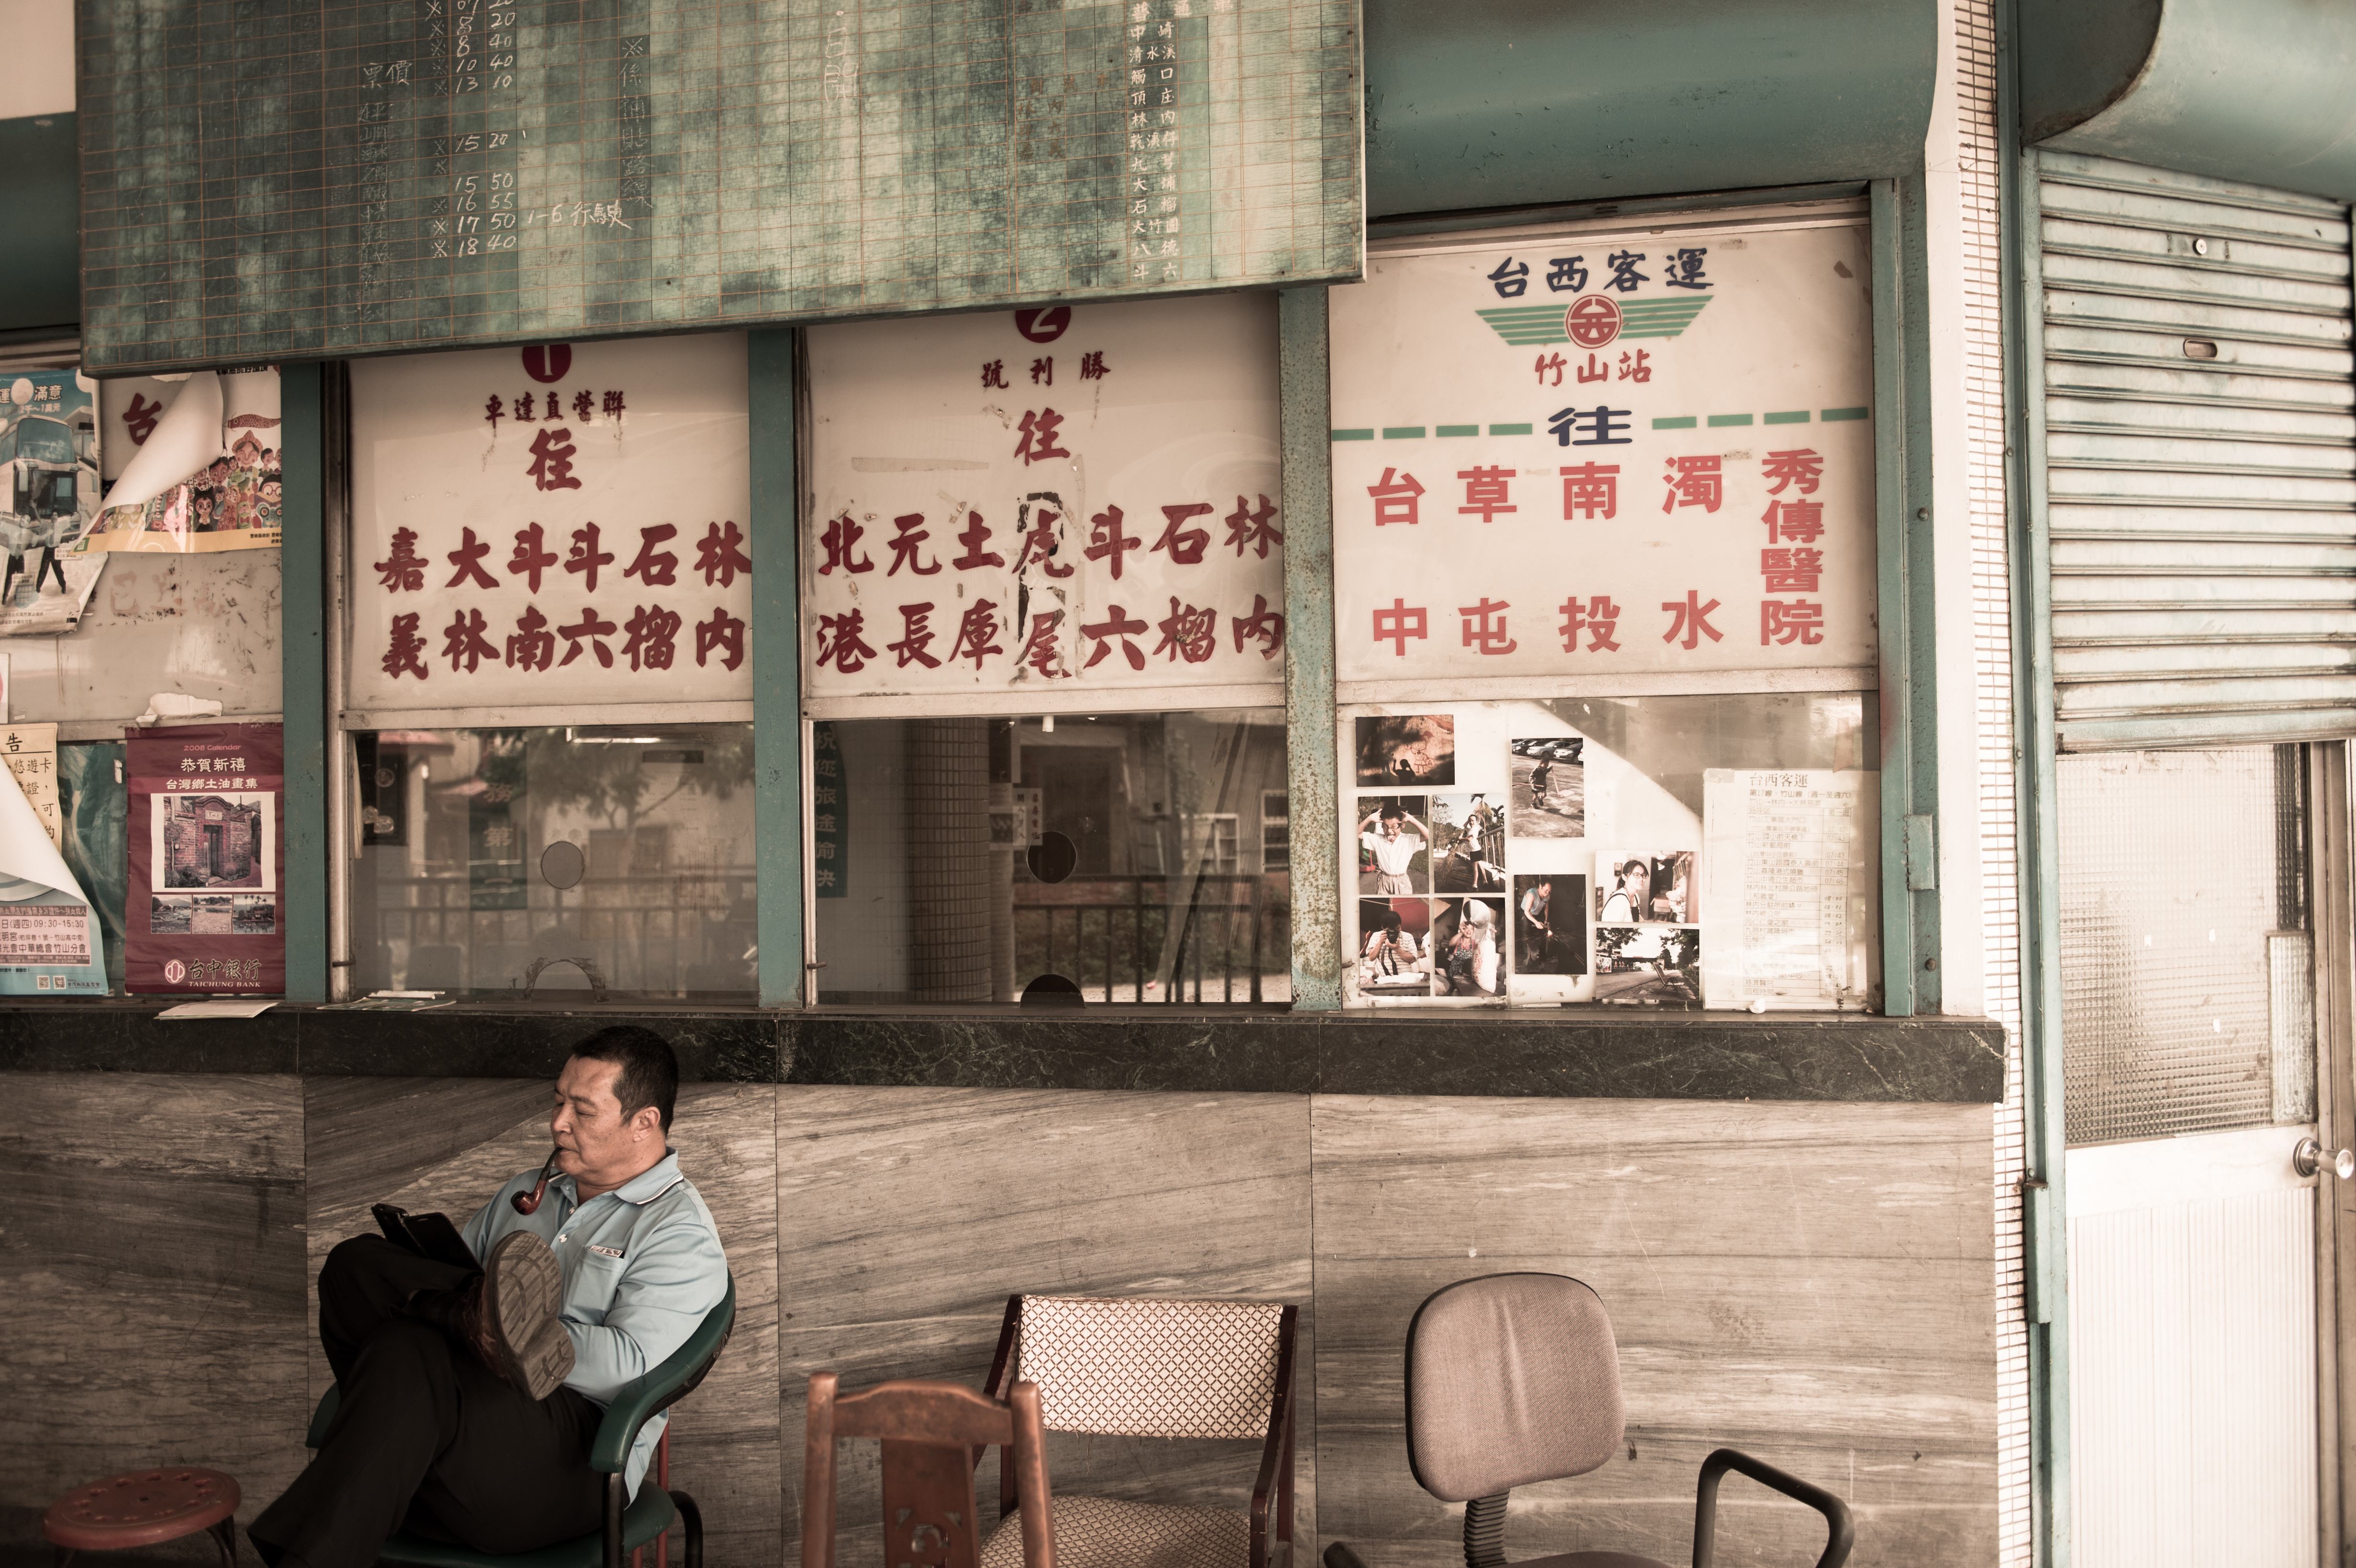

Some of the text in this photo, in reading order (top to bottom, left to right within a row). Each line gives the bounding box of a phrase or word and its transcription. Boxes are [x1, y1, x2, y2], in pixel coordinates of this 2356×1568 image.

[491, 12, 517, 28] 20
[1130, 21, 1174, 42] 中崎
[457, 33, 513, 57] 8 40
[1129, 44, 1176, 63] 清水溪
[457, 54, 513, 74] 10 40
[362, 60, 414, 89] 票價
[456, 75, 513, 94] 13 10
[1131, 67, 1173, 86] 觸口
[1131, 87, 1175, 106] 頂庄
[1017, 99, 1063, 118] 林內
[1132, 110, 1177, 127] 林內
[1019, 120, 1063, 140] 斗六
[455, 134, 481, 153] 15
[1130, 131, 1178, 150] 乾溪仔
[1131, 151, 1176, 172] 九芎
[455, 172, 513, 194] 15 50
[1132, 174, 1177, 192] 大埔
[457, 192, 516, 212] 16 55
[1131, 196, 1177, 214] 石榴
[458, 215, 480, 234] 17
[491, 213, 516, 230] 50
[458, 234, 517, 258] 18 40
[1131, 238, 1179, 258] 八德
[1132, 261, 1178, 281] 斗六
[1487, 247, 1714, 299] 台西客運
[1535, 349, 1651, 387] 竹山站
[34, 384, 63, 402] 滿意
[122, 393, 162, 446] 台
[1548, 405, 1633, 447] 往
[1014, 408, 1071, 467] 往
[526, 427, 582, 491] 往
[1760, 447, 1825, 646] 秀傳醫院
[5, 732, 24, 752] 告
[181, 757, 246, 773] 恭賀新禧
[166, 777, 258, 790] 台灣鄉土油畫集
[1750, 772, 1809, 788] 台西客運
[188, 958, 262, 980] 台中銀行
